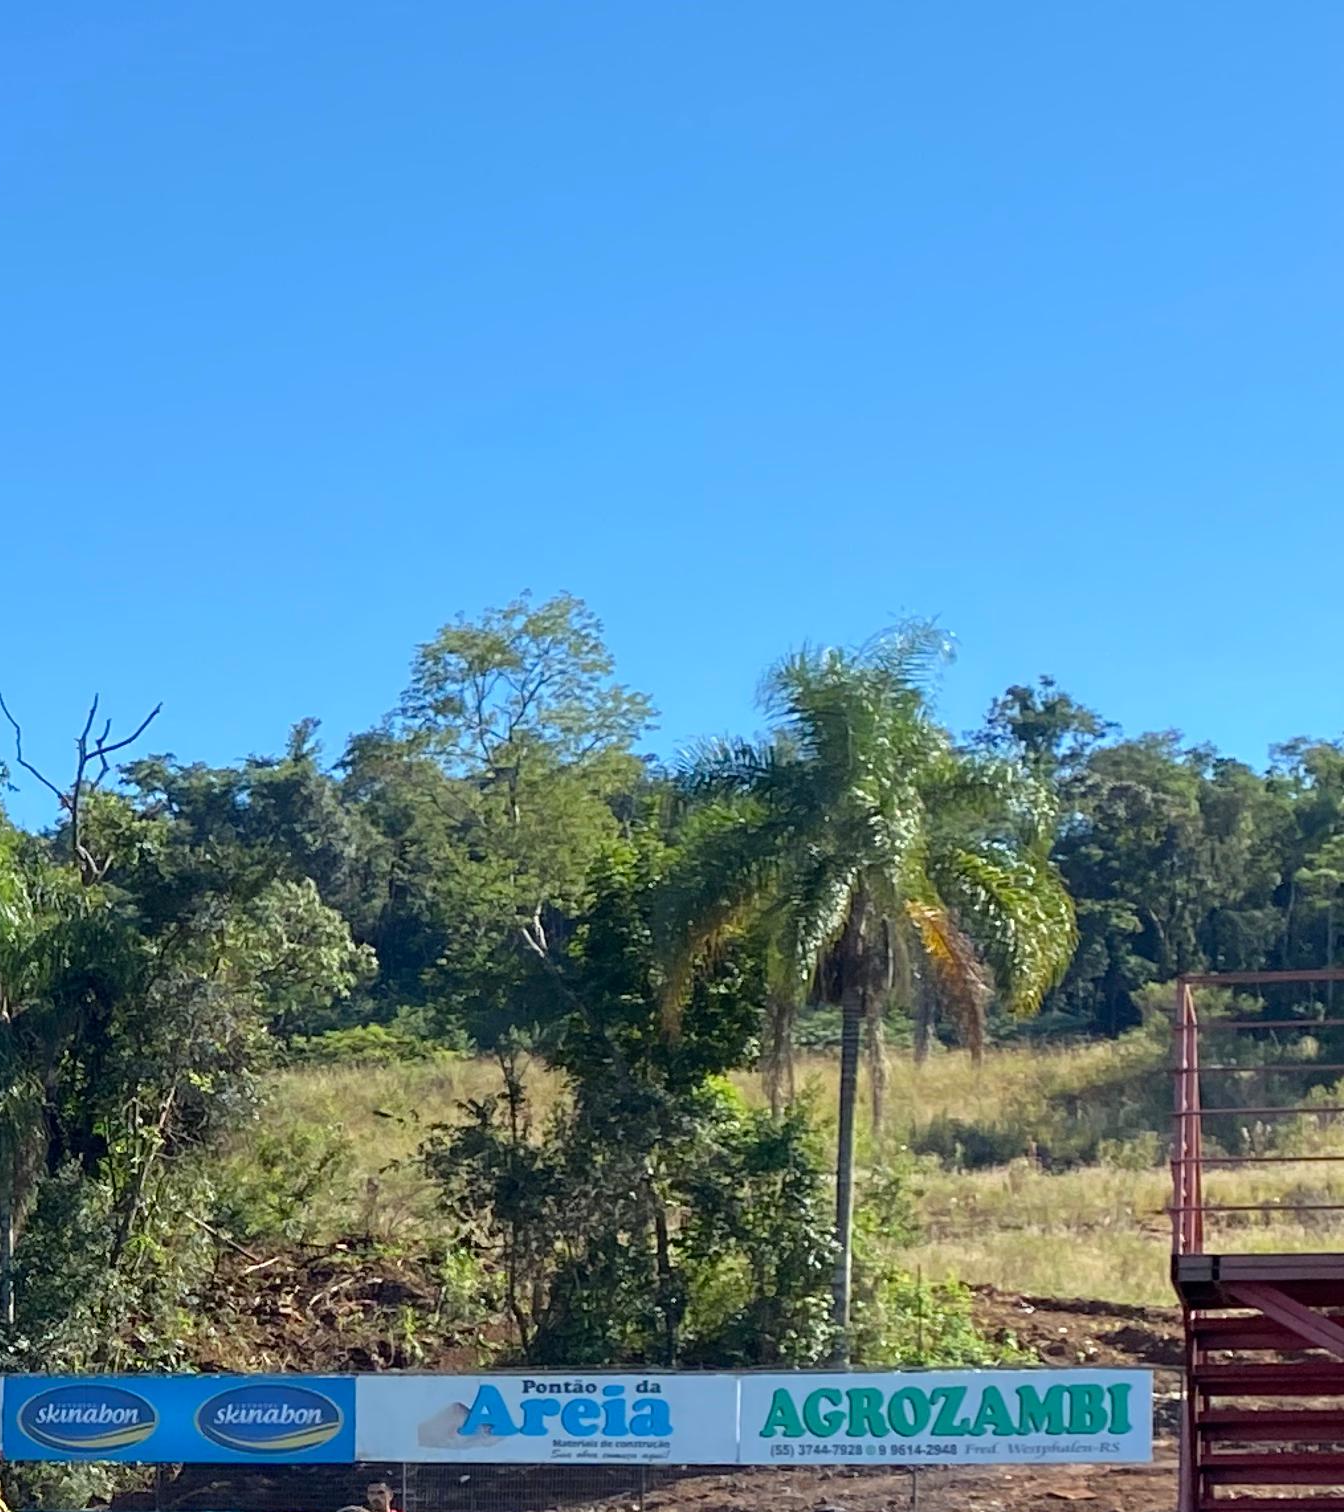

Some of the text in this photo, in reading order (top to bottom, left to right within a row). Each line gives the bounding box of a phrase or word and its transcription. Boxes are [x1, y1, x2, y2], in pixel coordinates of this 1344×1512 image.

[522, 1379, 662, 1394] Pontão da
[35, 1403, 140, 1425] skinabon
[213, 1403, 323, 1425] skinabon
[456, 1384, 674, 1437] Areia
[759, 1383, 1132, 1437] AGROZAMBI
[770, 1444, 795, 1458] (55)
[797, 1444, 864, 1457] 3744-7928
